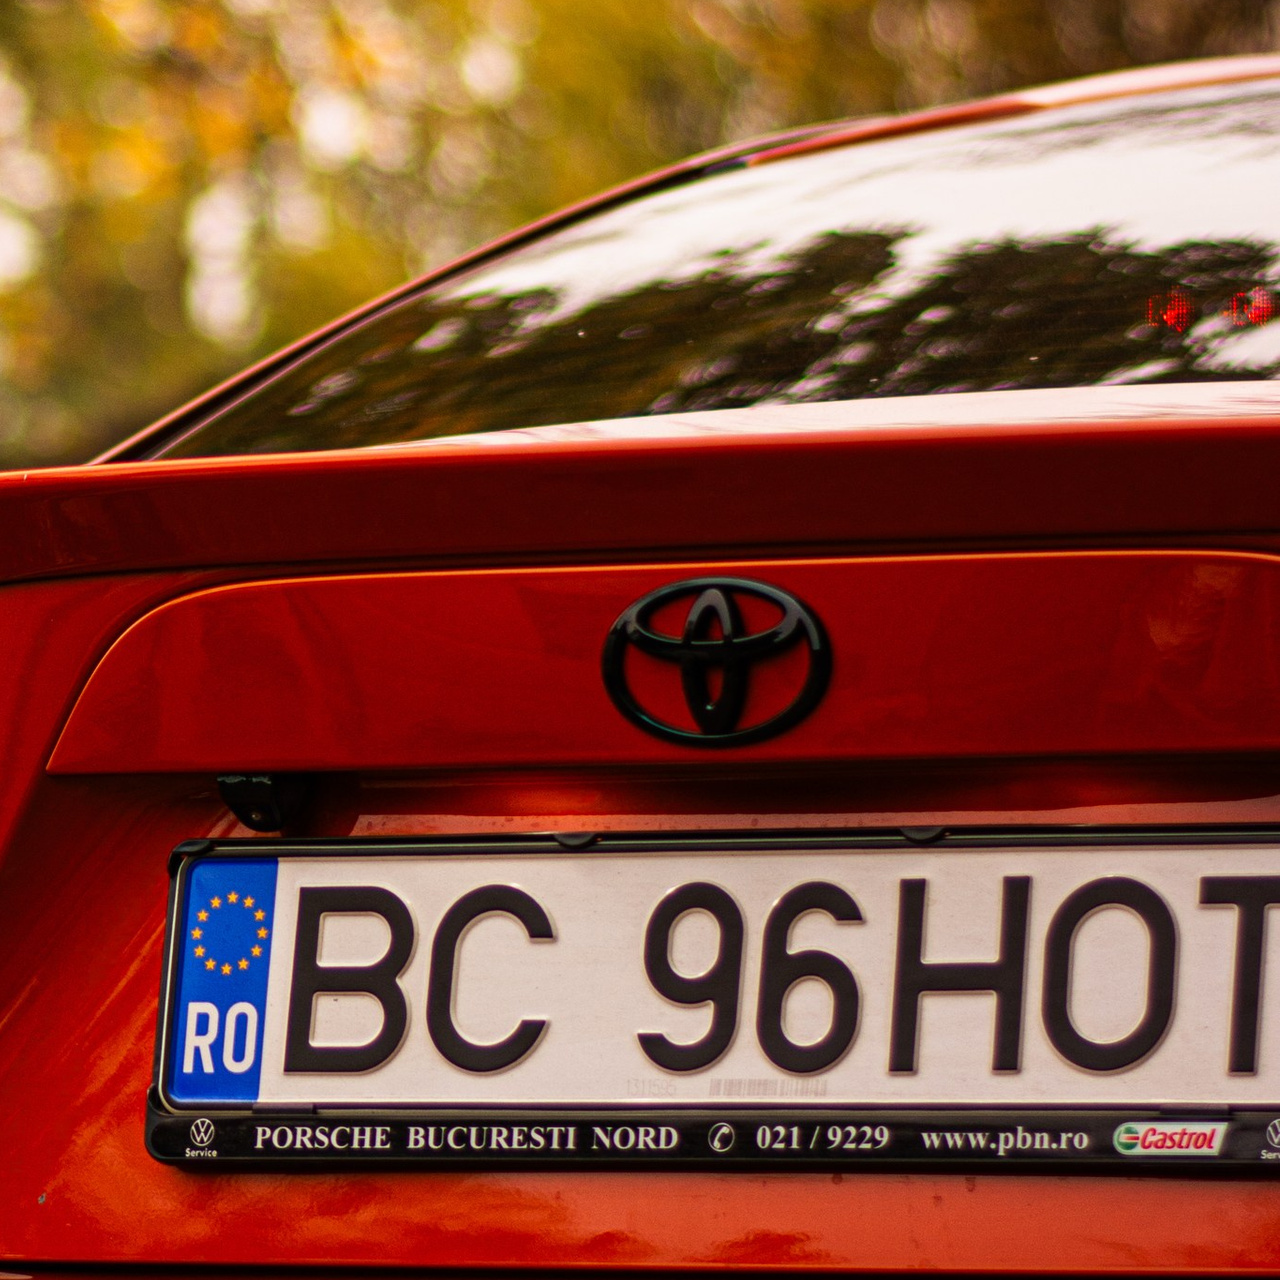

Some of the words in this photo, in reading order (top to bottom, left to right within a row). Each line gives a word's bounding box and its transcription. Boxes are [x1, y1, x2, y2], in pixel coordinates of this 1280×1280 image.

[283, 883, 554, 1074] BC
[637, 876, 1280, 1074] 96HOT
[183, 1001, 258, 1074] RO
[185, 1148, 218, 1158] Service
[254, 1126, 391, 1149] PORSCHE
[406, 1126, 577, 1150] BUCURESTI
[591, 1126, 678, 1150] NORD
[756, 1125, 800, 1149] 021
[826, 1125, 889, 1149] 9229
[921, 1126, 1089, 1155] www.pbn.ro
[1140, 1127, 1216, 1150] Castrol
